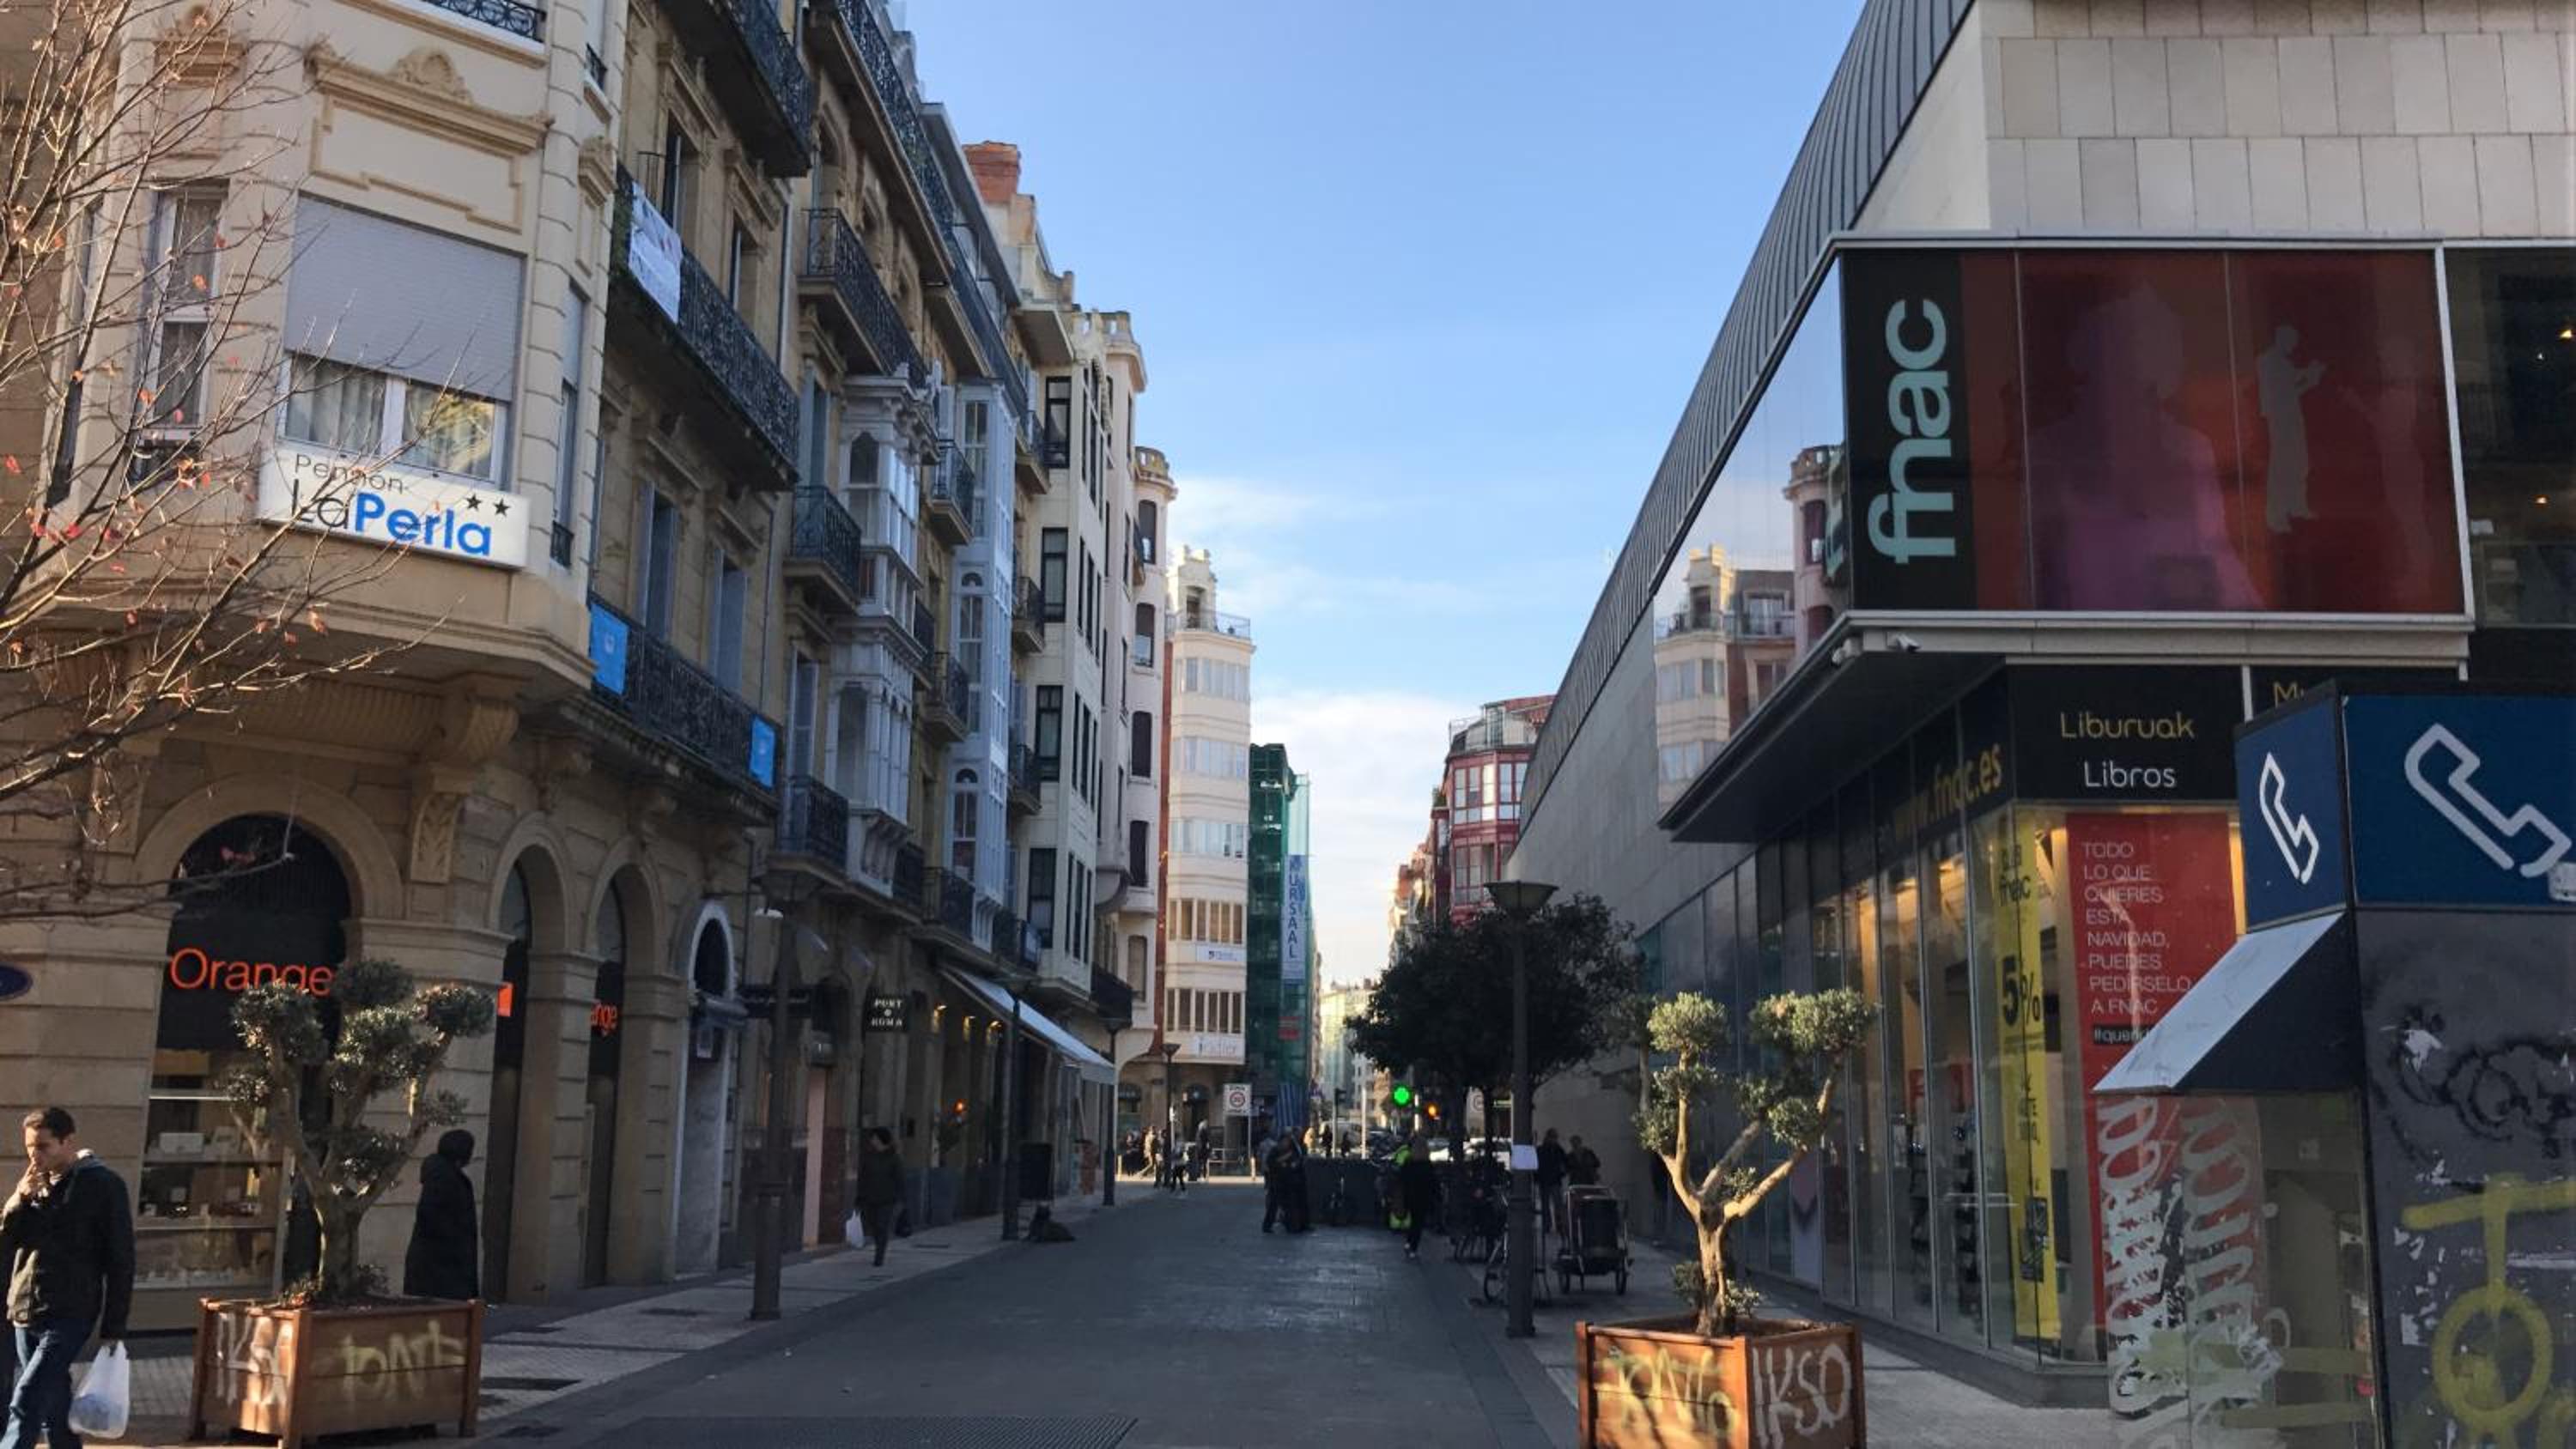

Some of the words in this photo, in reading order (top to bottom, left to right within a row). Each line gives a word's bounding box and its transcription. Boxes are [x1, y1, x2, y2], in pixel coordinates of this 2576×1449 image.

[1868, 299, 1956, 564] fnac
[2060, 712, 2196, 739] Liburuak
[2083, 760, 2177, 788] Libros
[2081, 842, 2134, 858] TODO
[2084, 864, 2108, 880] LO
[2111, 864, 2152, 880] QUE
[2084, 885, 2165, 903] QUIERES
[2088, 953, 2162, 970] PUEDES
[170, 947, 334, 996] Orange
[2091, 998, 2105, 1015] A
[2109, 998, 2158, 1015] FNAC
